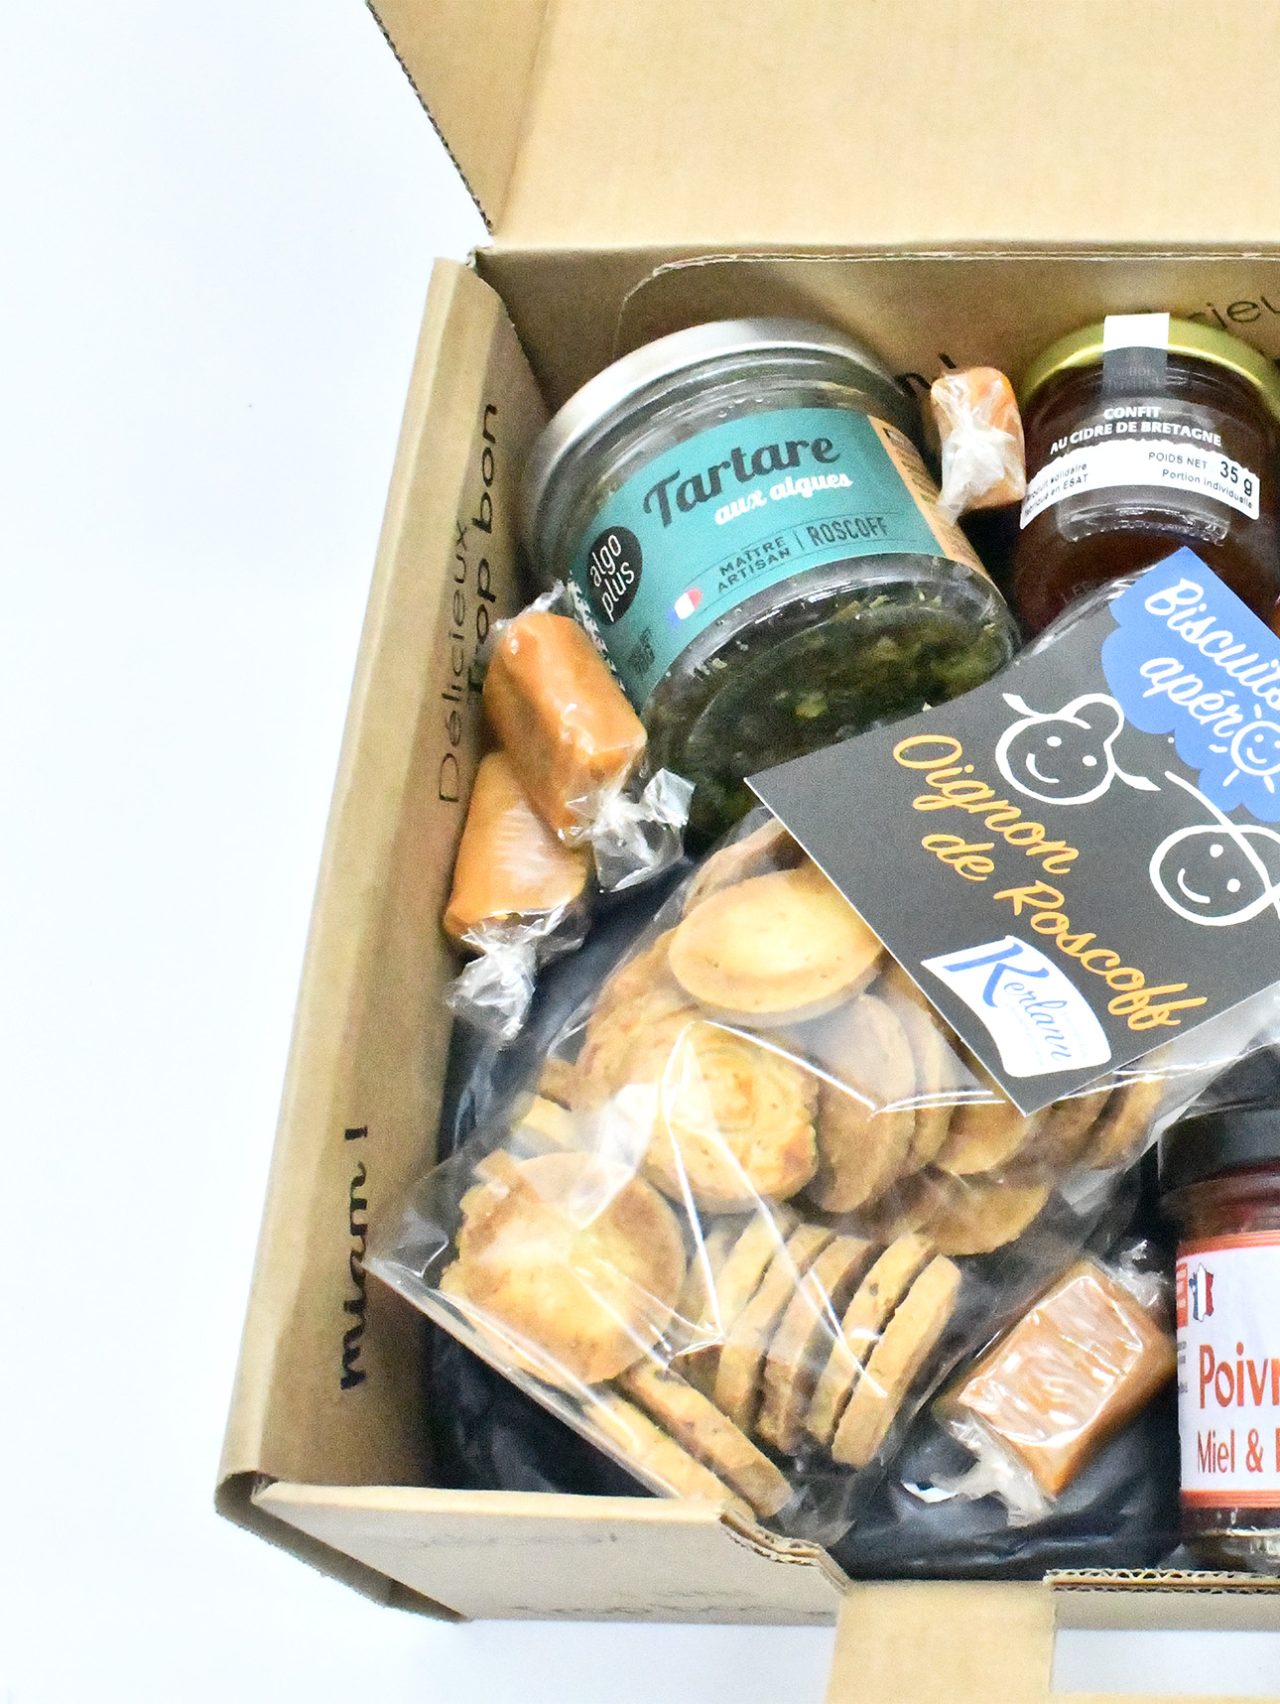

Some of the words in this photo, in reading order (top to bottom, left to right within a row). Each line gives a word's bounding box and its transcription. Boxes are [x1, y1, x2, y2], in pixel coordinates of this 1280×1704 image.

[1050, 436, 1068, 454] AU
[1070, 423, 1113, 445] CIDRE
[1116, 421, 1137, 433] DE
[1140, 421, 1222, 447] BRETAGNE
[1103, 406, 1162, 420] CONFIT
[472, 403, 498, 534] bon
[643, 436, 841, 529] Tartare
[1148, 451, 1183, 464] POIDS
[1186, 457, 1208, 469] NET
[1220, 461, 1239, 484] 35
[1243, 478, 1253, 497] g
[1162, 468, 1201, 483] Portion
[1203, 478, 1253, 509] individuelle
[714, 490, 768, 526] aux
[769, 472, 854, 499] algues
[806, 516, 889, 548] ROSCOFF
[588, 533, 623, 588] algo
[717, 547, 791, 593] ARTISAN
[600, 563, 636, 622] plus
[438, 521, 469, 803] Délicieux
[892, 734, 1081, 875] Oignon
[920, 832, 996, 883] de
[992, 880, 1209, 1033] Roscoff
[943, 942, 1072, 1062] Kerlann
[1197, 1429, 1236, 1474] Miel
[1245, 1430, 1264, 1473] &
